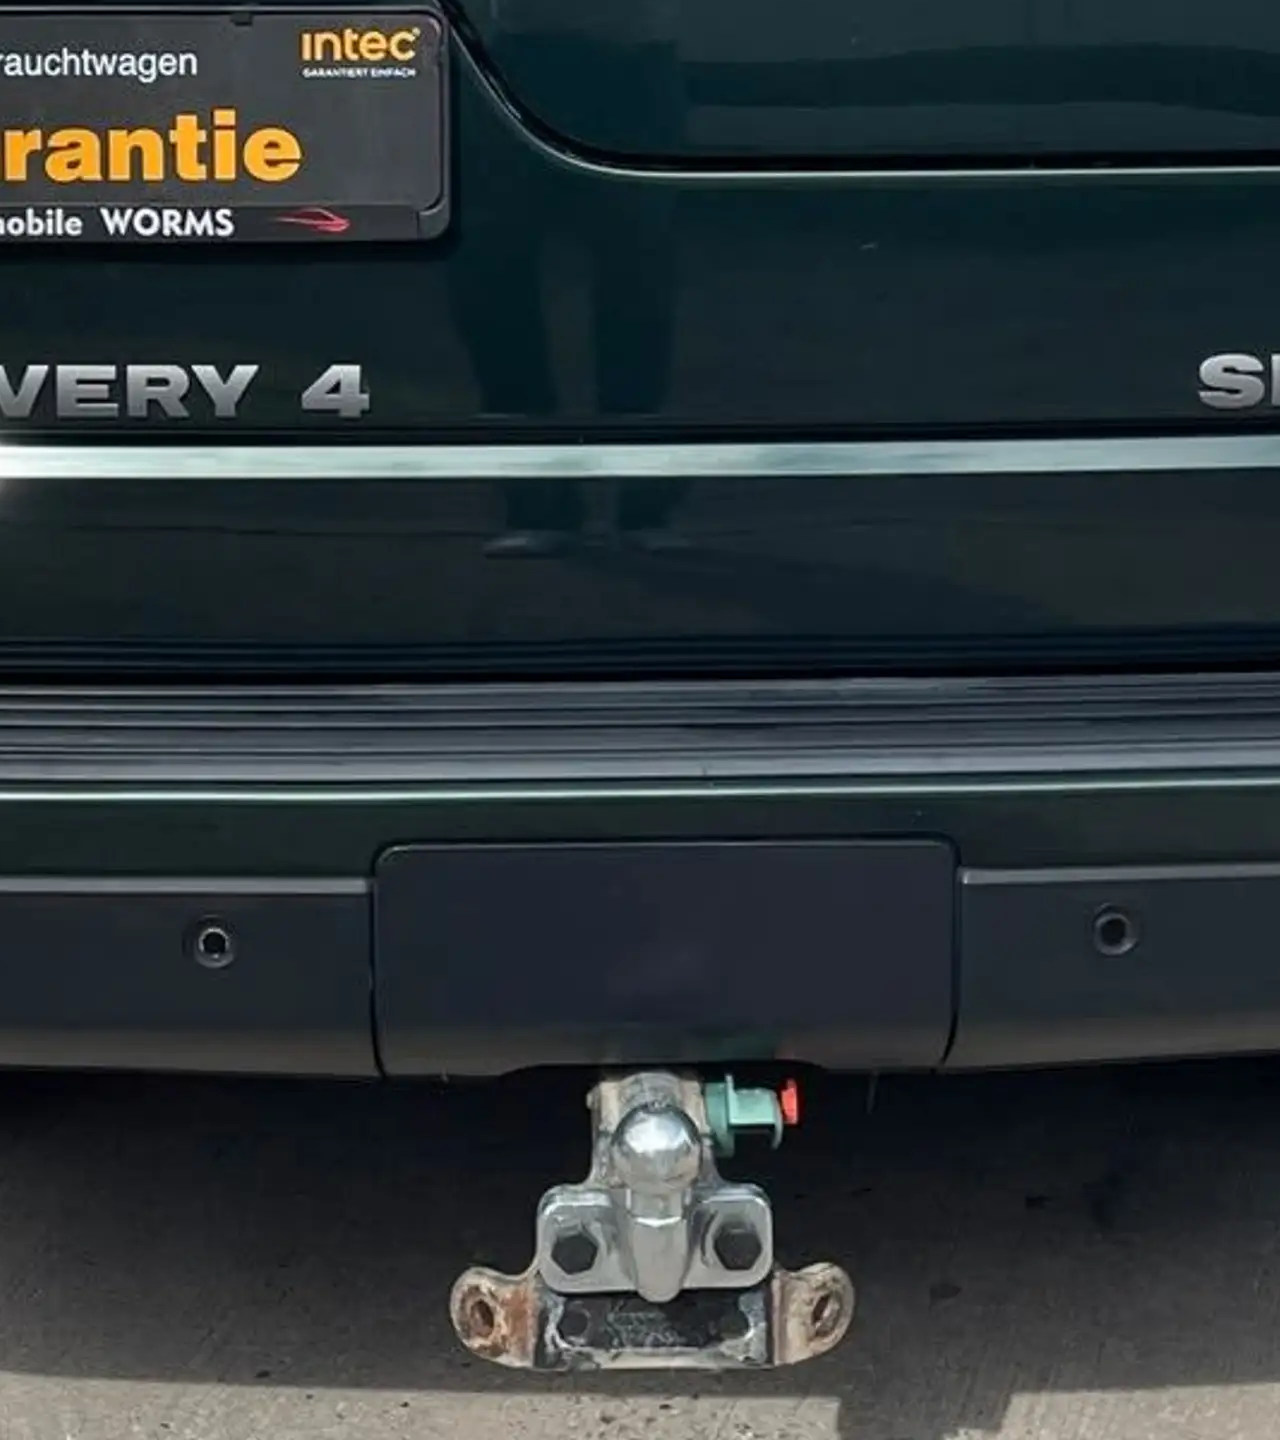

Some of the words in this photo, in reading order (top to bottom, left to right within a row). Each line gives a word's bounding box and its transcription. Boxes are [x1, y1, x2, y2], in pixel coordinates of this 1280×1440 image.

[301, 27, 418, 62] intec
[100, 207, 235, 238] WORMS
[301, 364, 371, 418] 4
